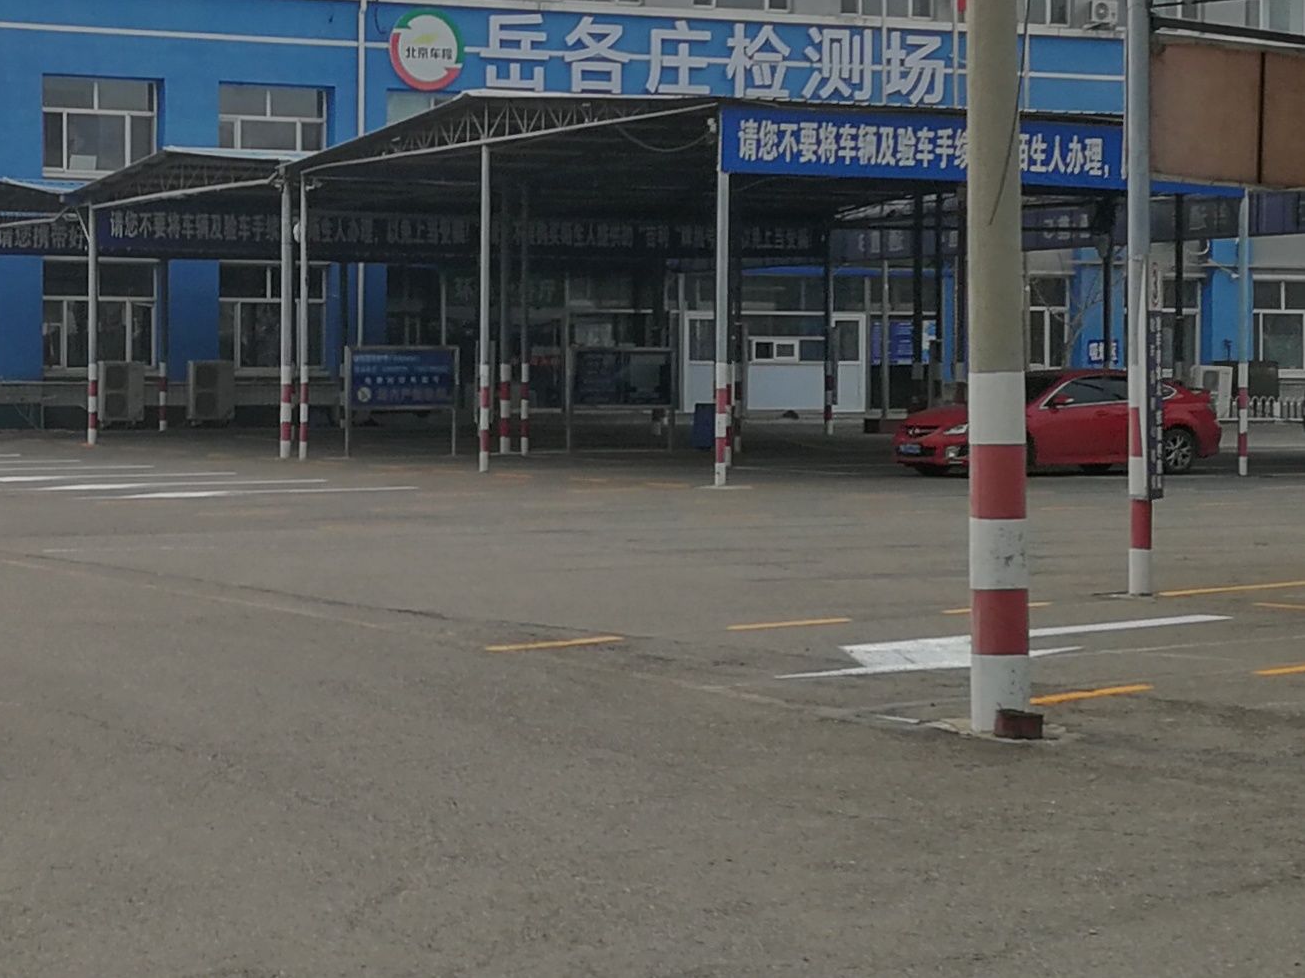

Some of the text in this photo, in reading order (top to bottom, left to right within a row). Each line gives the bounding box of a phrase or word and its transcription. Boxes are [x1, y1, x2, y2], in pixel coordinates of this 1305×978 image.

[479, 13, 947, 105] 岳各庄检测场
